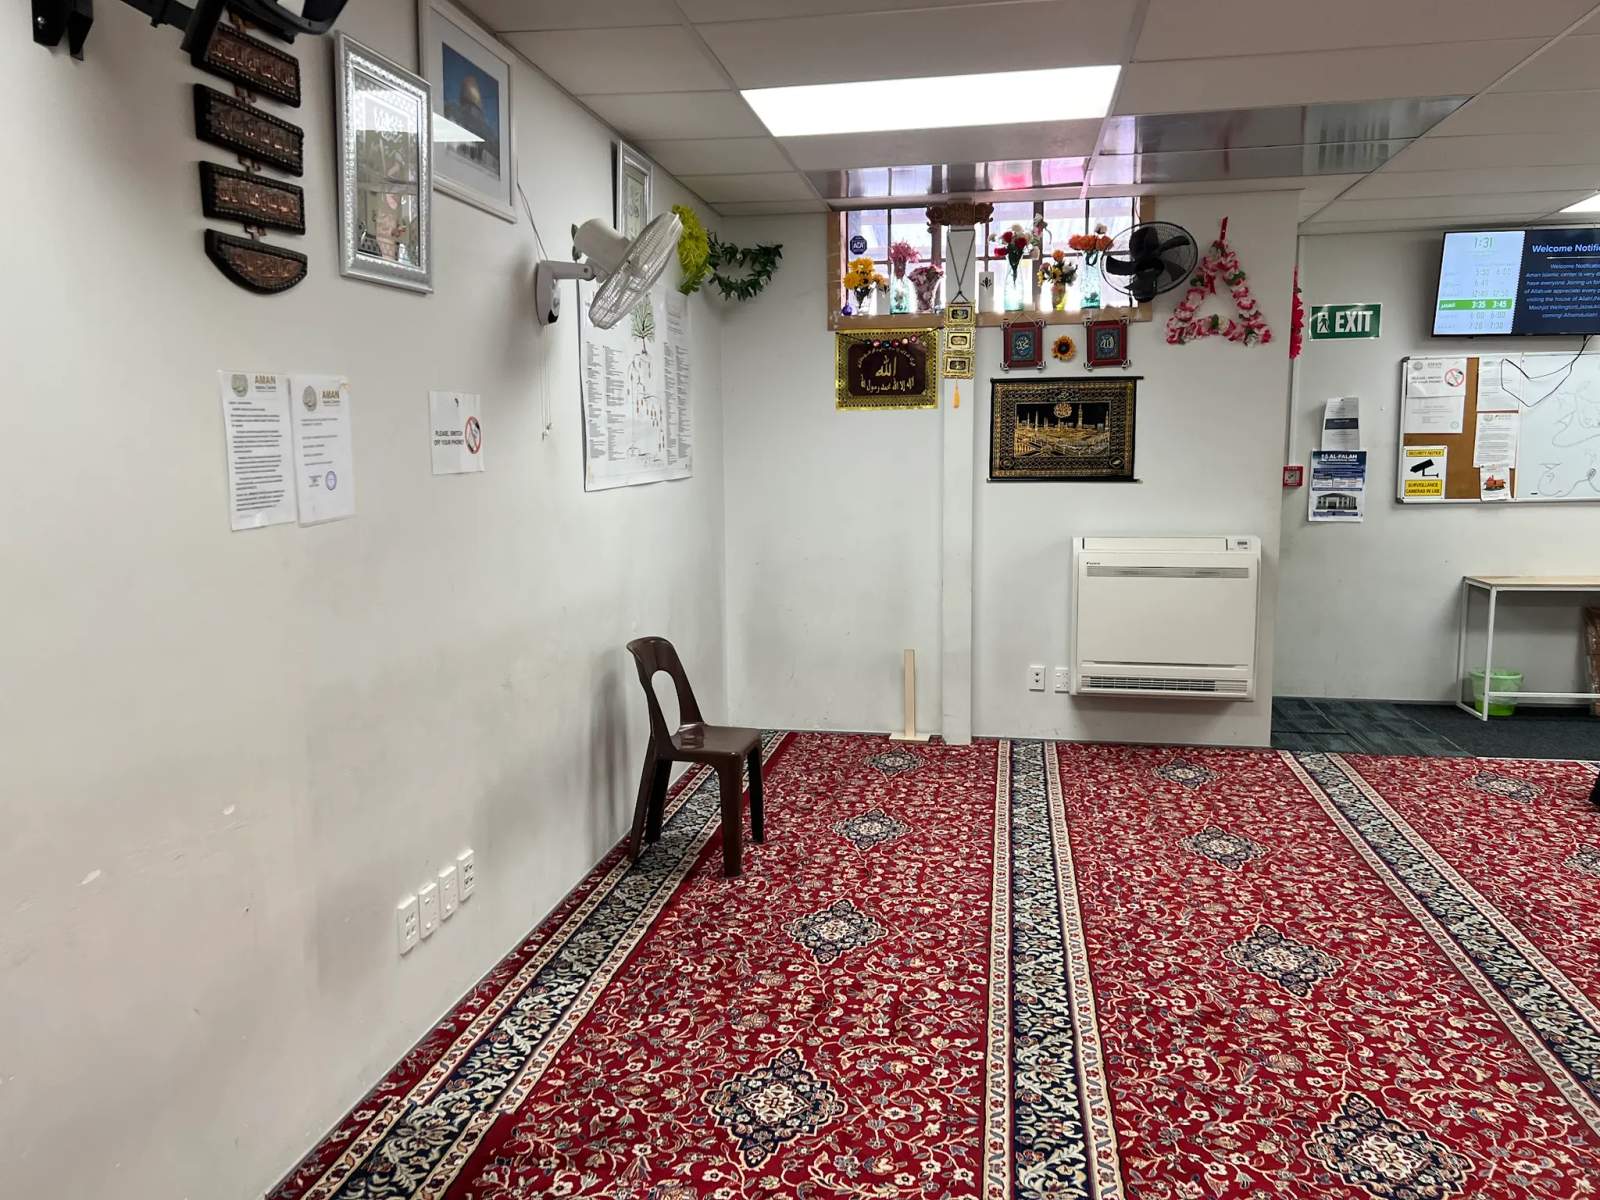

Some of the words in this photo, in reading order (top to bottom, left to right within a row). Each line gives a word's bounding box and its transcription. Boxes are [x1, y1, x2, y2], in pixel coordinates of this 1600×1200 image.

[1474, 237, 1493, 249] 1:31
[1532, 244, 1573, 253] Welcome
[1335, 310, 1373, 332] EXIT
[875, 354, 897, 377] الله
[254, 375, 277, 385] AMAN
[321, 390, 340, 400] AMAN
